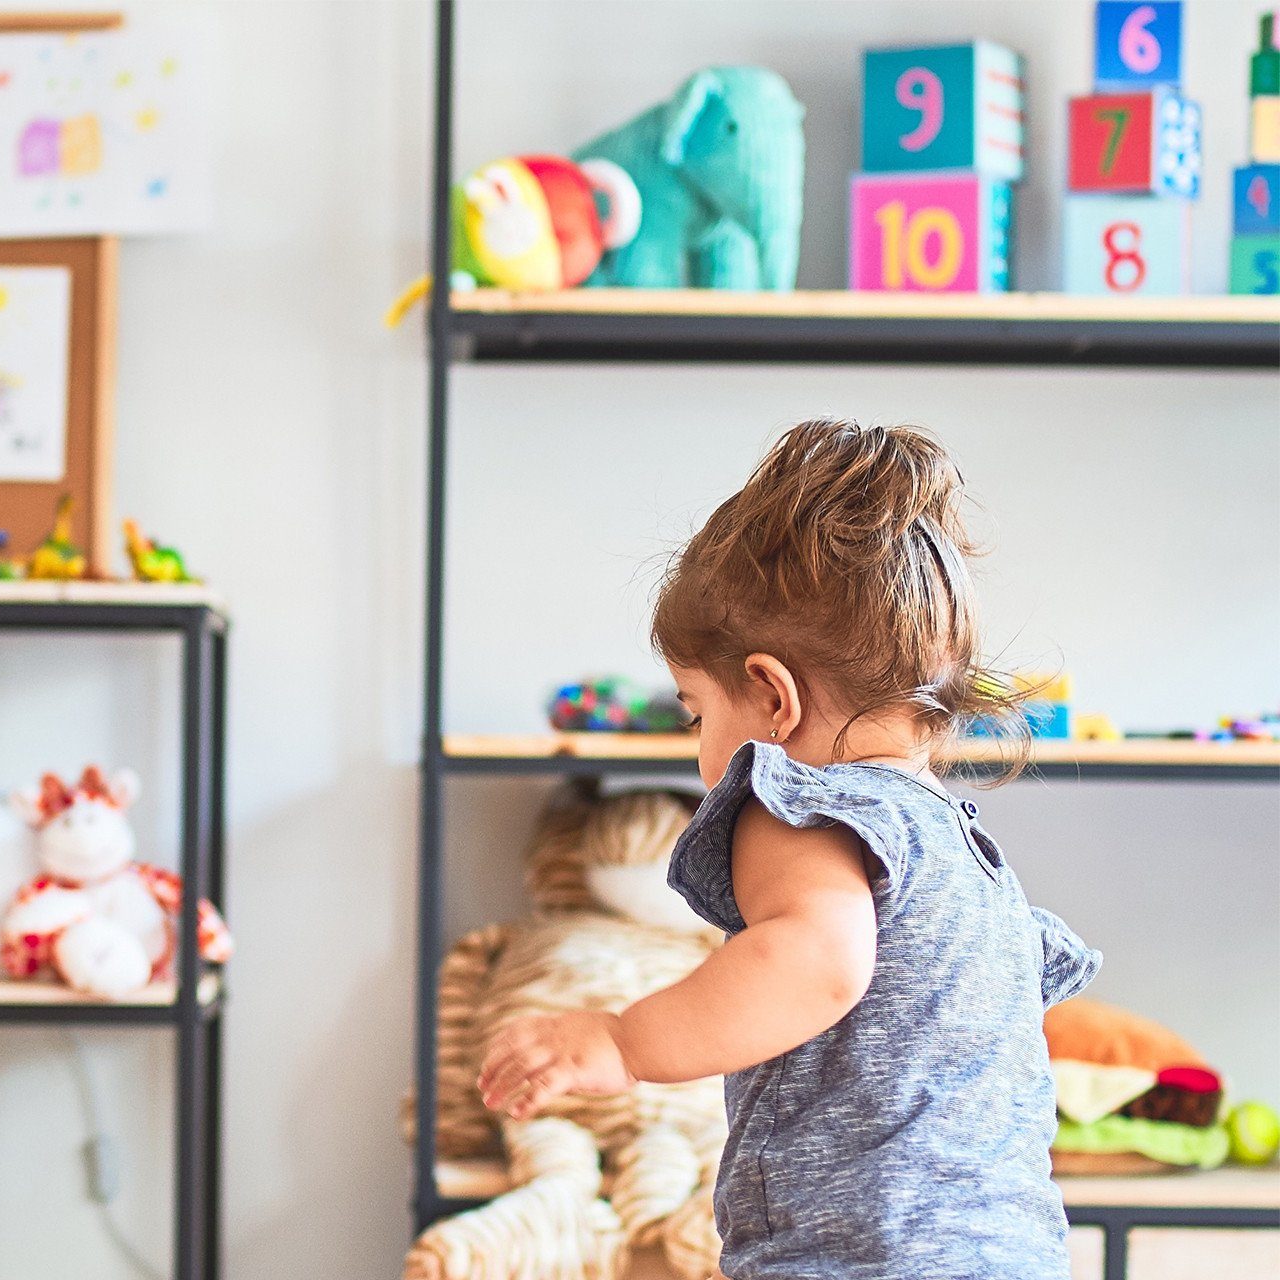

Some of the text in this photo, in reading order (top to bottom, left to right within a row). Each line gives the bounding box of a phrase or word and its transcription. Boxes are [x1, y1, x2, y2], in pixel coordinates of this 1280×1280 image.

[1118, 5, 1162, 74] 6
[895, 66, 944, 153] 9
[1093, 108, 1130, 176] 7
[875, 200, 964, 291] 10
[1102, 219, 1147, 294] 8
